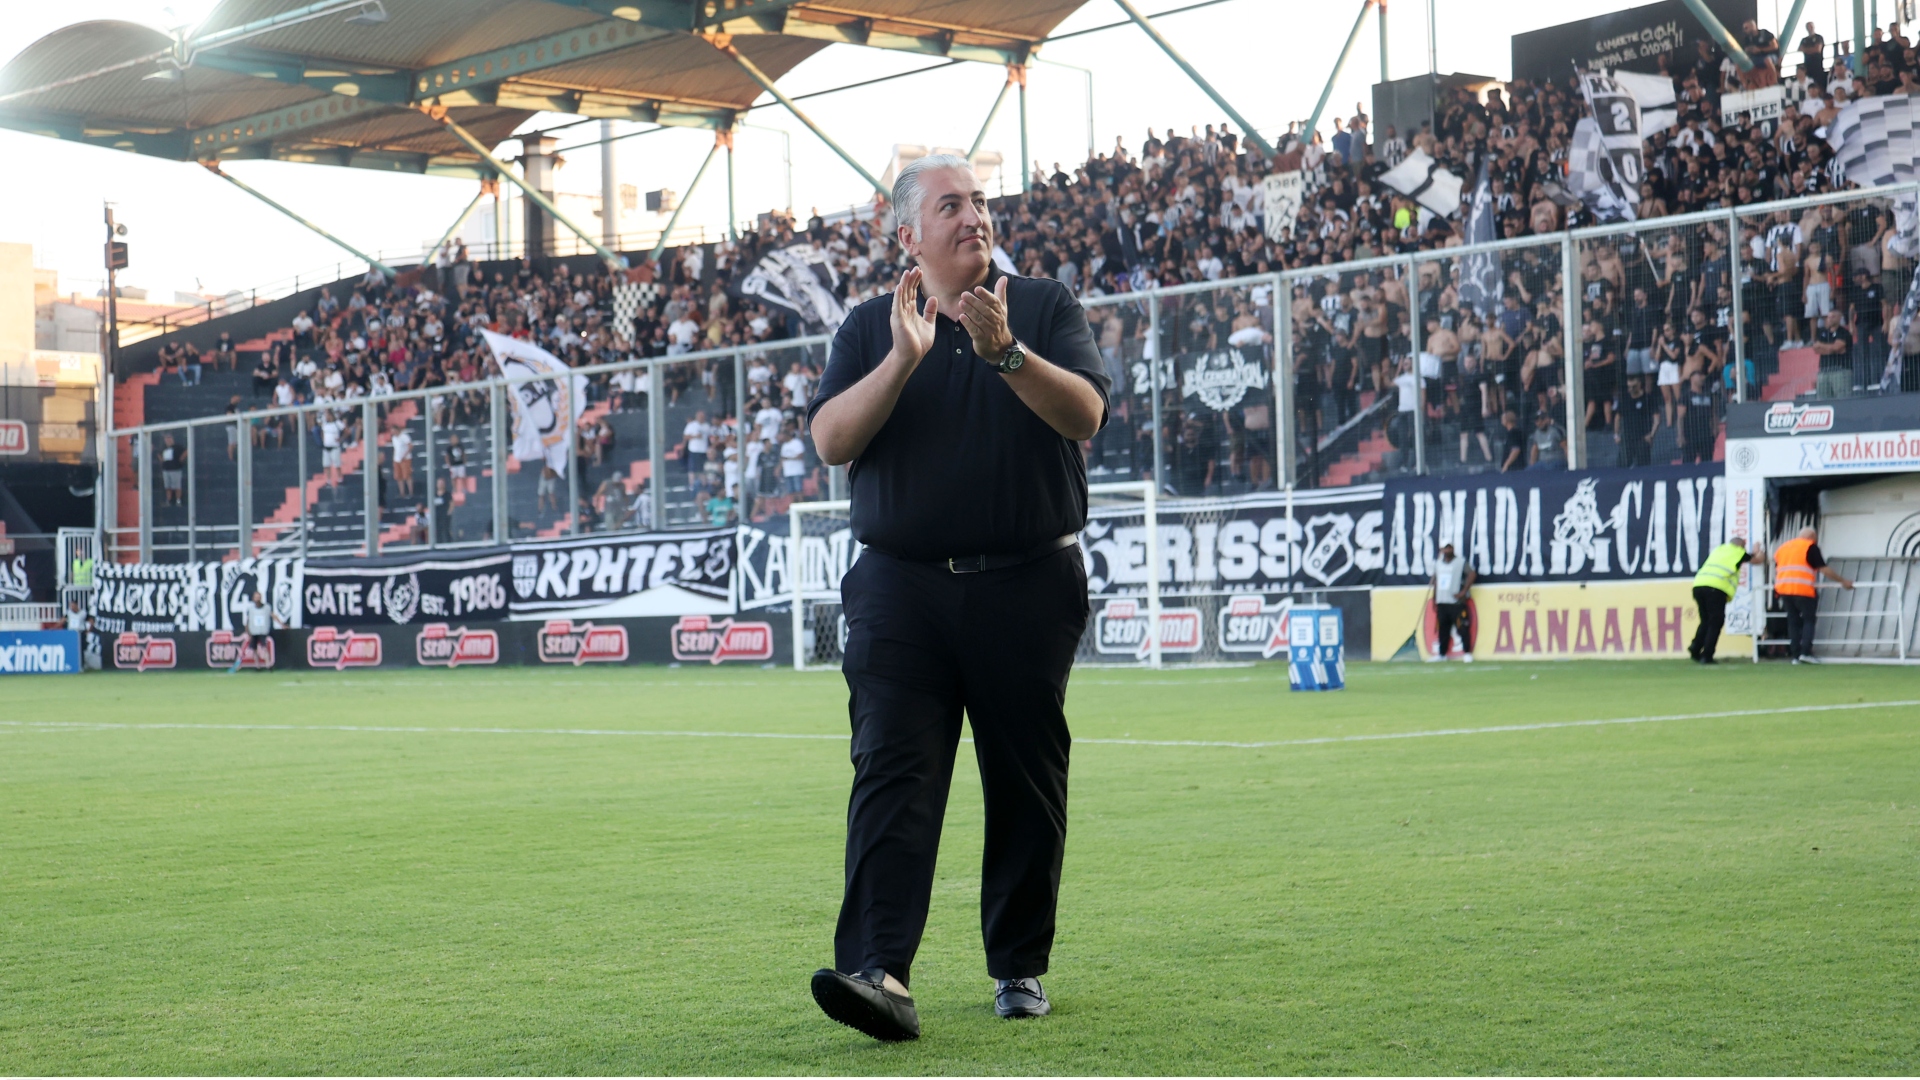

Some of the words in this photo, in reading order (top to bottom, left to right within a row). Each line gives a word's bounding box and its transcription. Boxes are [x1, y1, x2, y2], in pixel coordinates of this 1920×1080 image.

[1725, 103, 1777, 124] ΚΡΤΕΣ
[1385, 486, 1545, 577] ARMADA
[536, 539, 708, 598] ΚΡΗΤΕΣ
[305, 583, 363, 616] GATE
[367, 582, 382, 615] 4
[421, 593, 449, 616] EST.
[450, 573, 506, 616] 1986
[1494, 606, 1683, 653] ΔΑΝΔΑΛΗ
